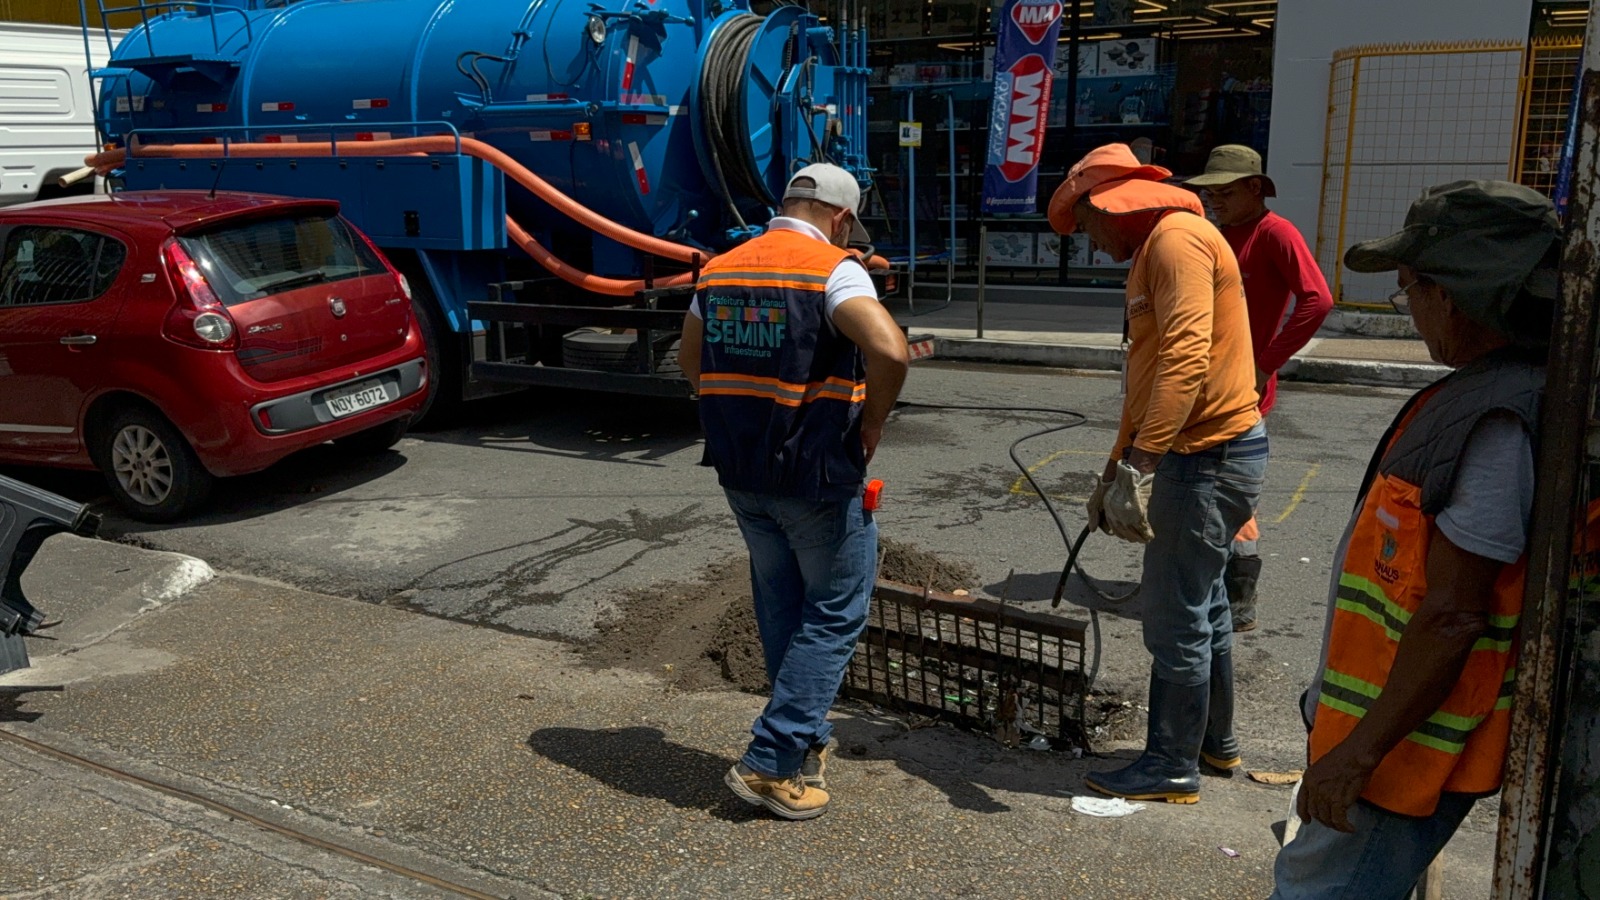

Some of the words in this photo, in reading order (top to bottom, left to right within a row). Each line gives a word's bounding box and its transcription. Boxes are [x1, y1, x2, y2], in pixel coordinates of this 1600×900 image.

[1019, 6, 1055, 24] MM
[1042, 73, 1051, 101] atacado
[1006, 68, 1044, 165] MM
[1041, 102, 1047, 112] do
[1039, 113, 1047, 133] preço
[708, 295, 745, 306] Prefeitura
[760, 298, 786, 308] Manaus
[706, 319, 786, 348] SEMINF
[724, 345, 771, 358] Infraestrutura
